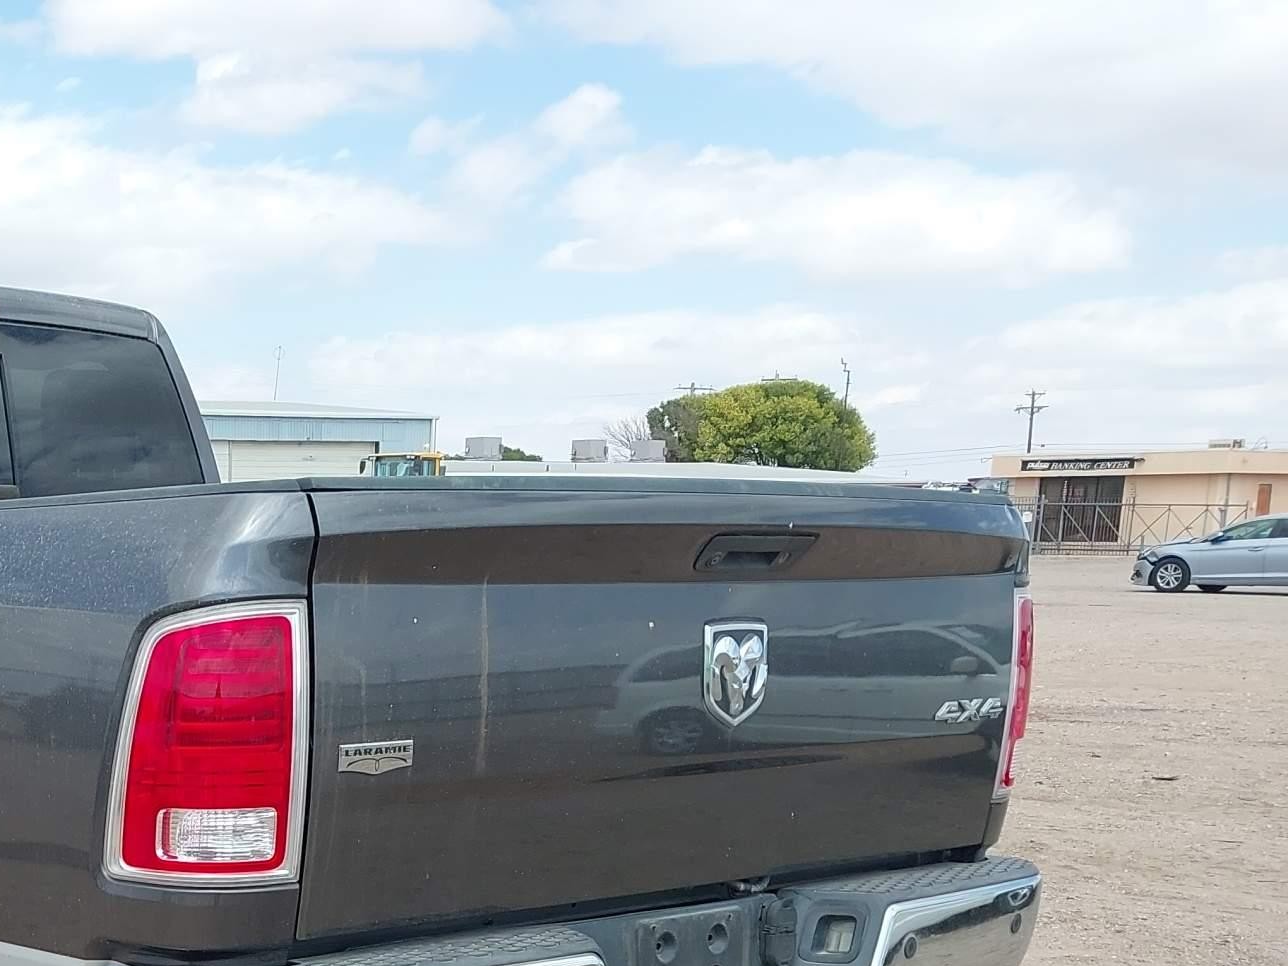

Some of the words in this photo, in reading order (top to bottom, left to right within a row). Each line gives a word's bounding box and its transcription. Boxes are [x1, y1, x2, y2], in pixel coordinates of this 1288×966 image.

[1050, 462, 1091, 471] BANKING
[1093, 460, 1130, 470] CENTER
[344, 744, 412, 757] LARAMIE
